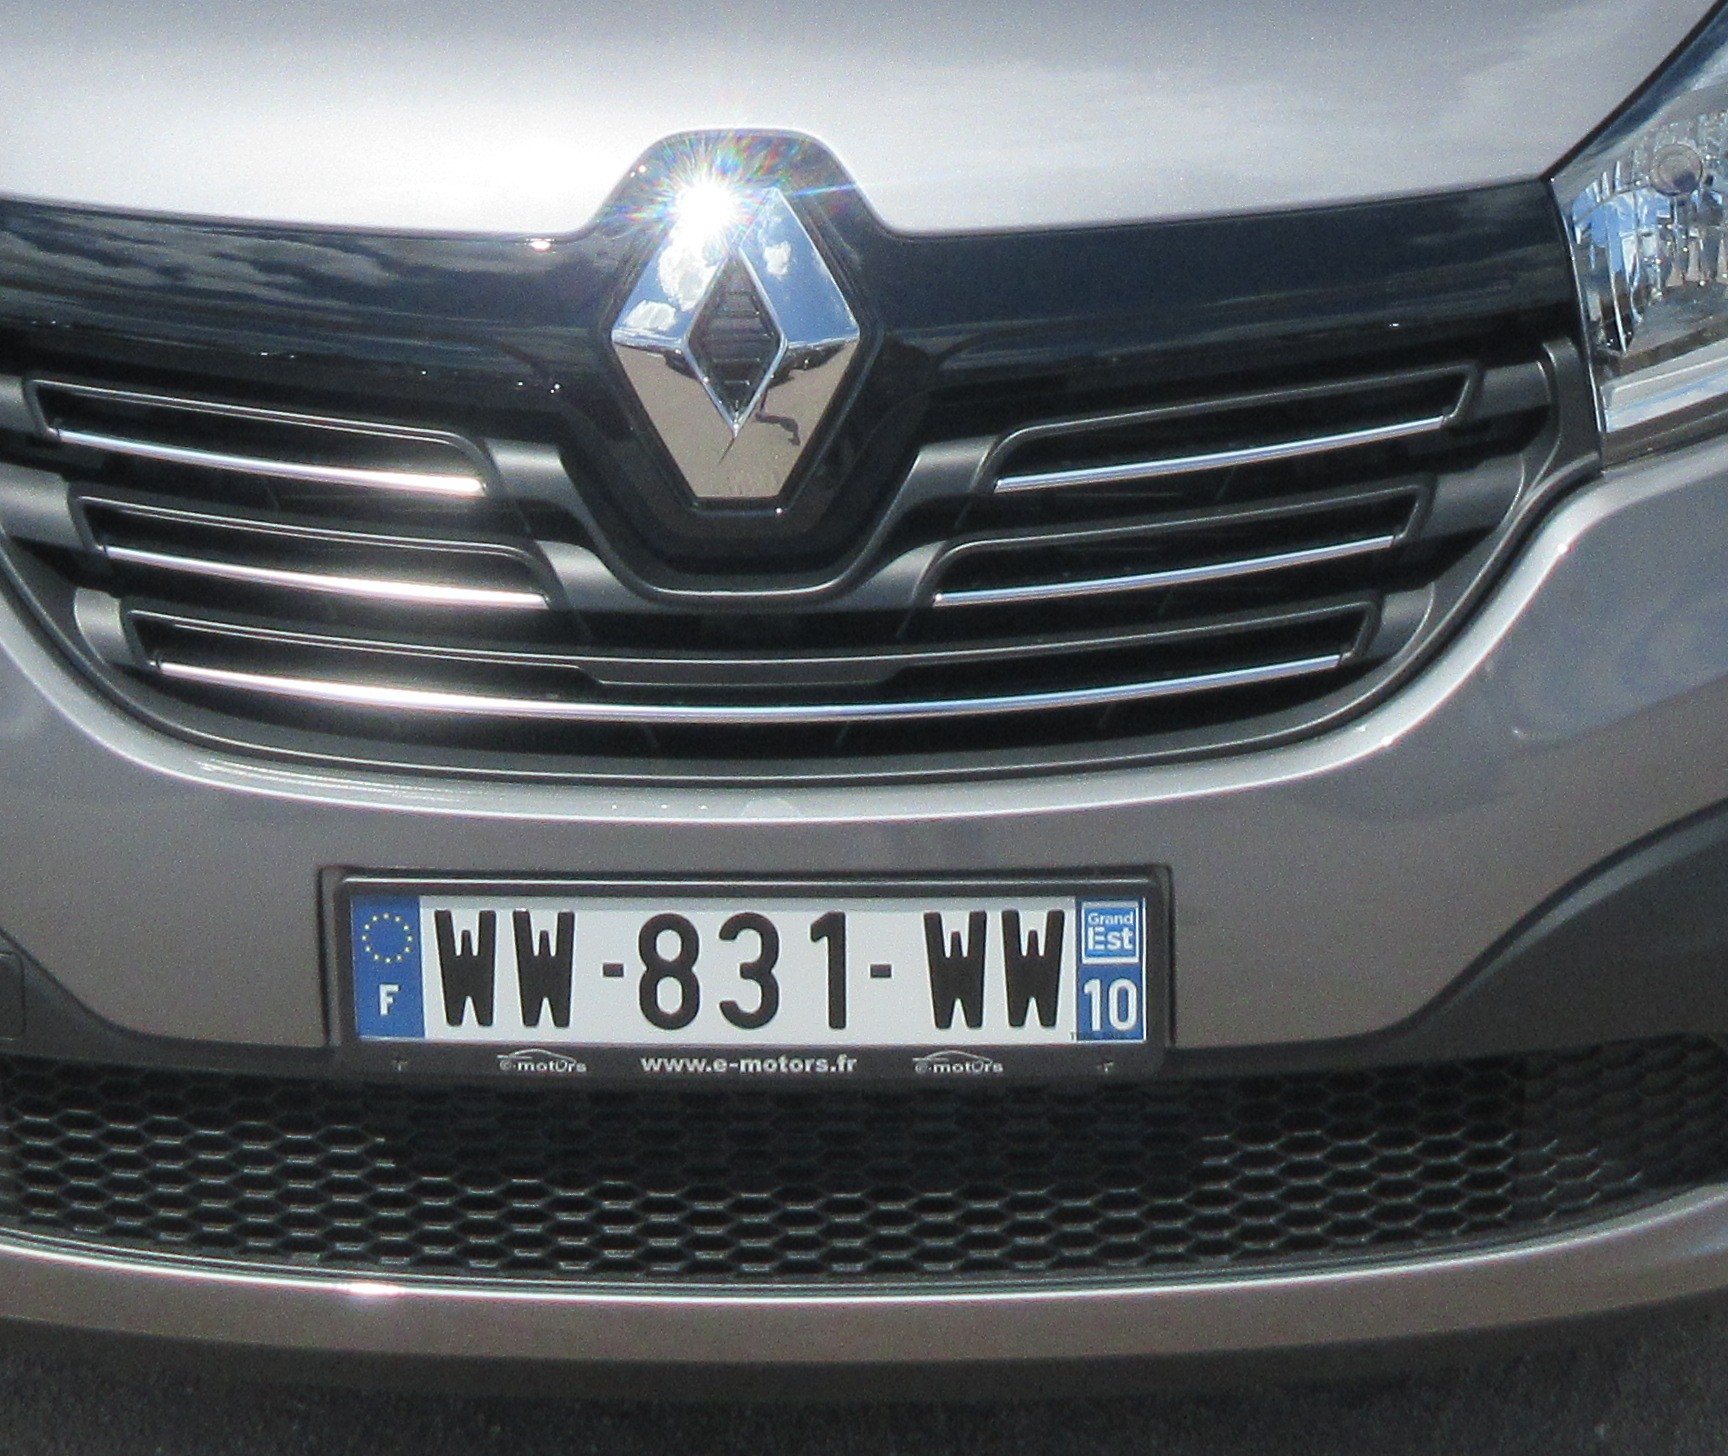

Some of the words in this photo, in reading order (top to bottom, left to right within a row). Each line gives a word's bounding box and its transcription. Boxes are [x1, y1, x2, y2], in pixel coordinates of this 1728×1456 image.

[1087, 912, 1134, 926] Grand
[1087, 926, 1134, 951] Est
[378, 983, 400, 1017] F
[1083, 978, 1138, 1032] 10
[640, 1054, 858, 1073] www.e-motors.fr
